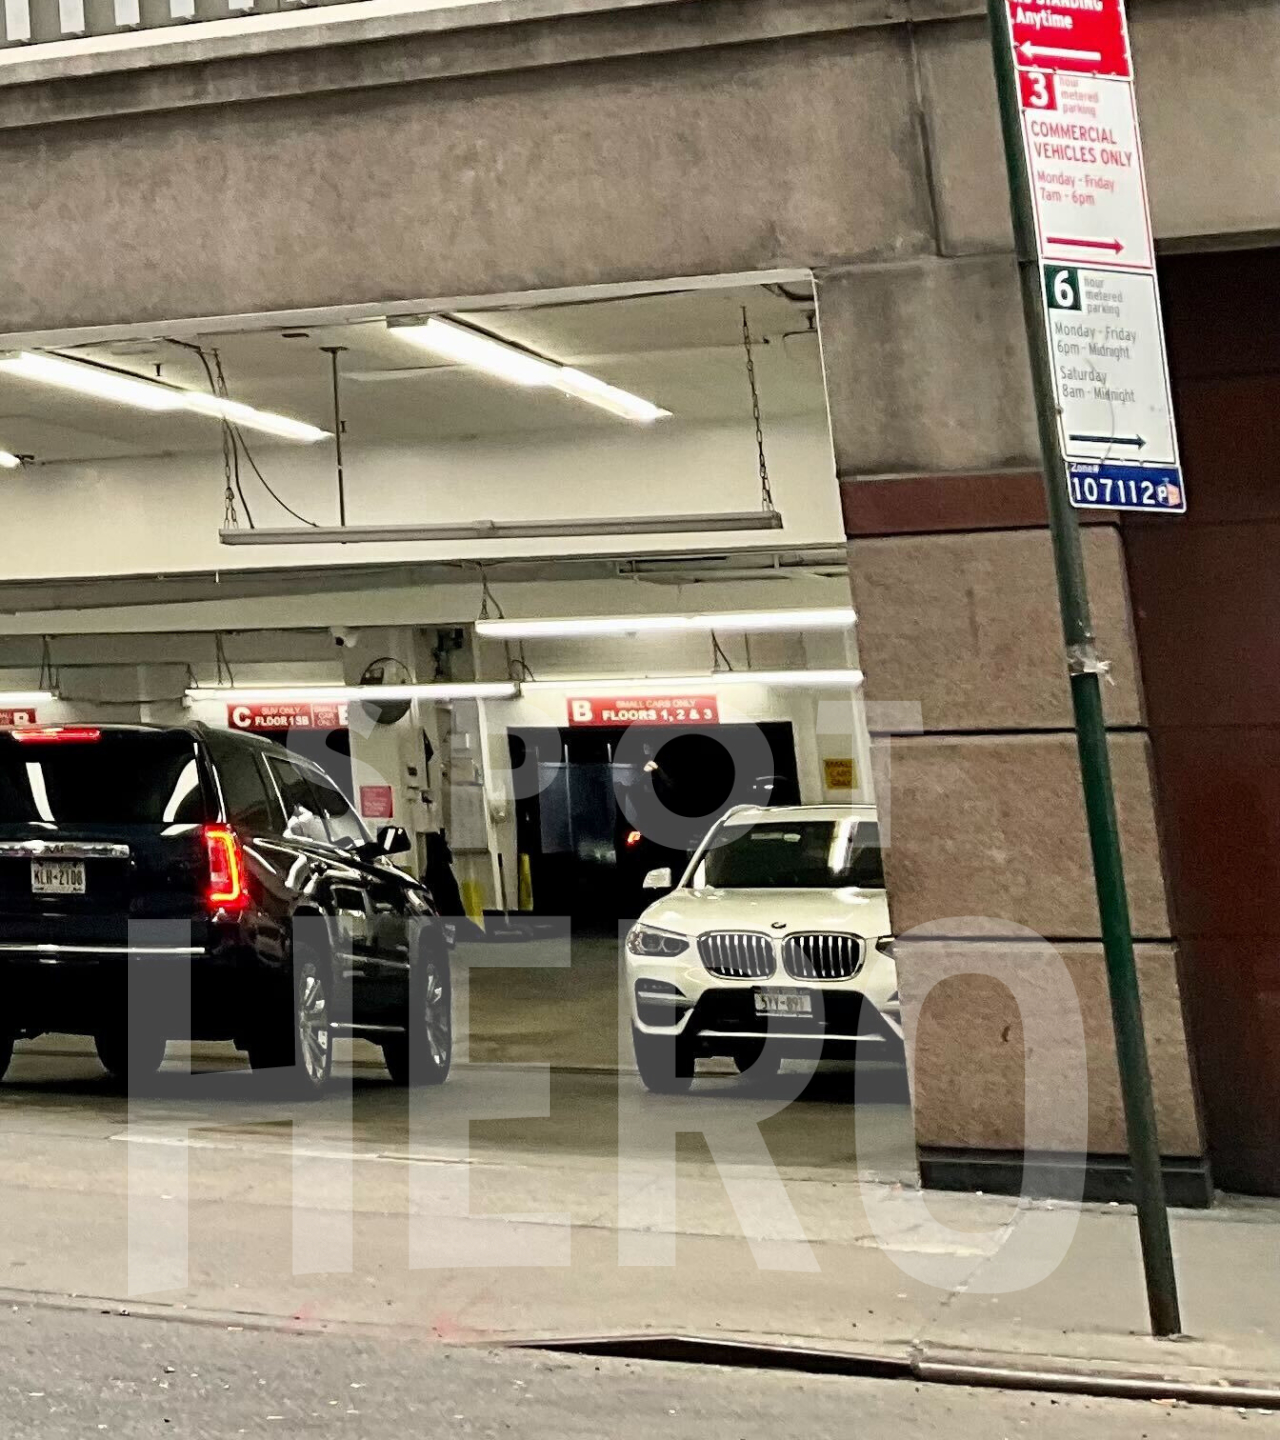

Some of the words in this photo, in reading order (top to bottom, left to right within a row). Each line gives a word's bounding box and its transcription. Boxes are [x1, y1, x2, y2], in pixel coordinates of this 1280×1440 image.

[1016, 7, 1073, 30] Anytime
[1029, 72, 1049, 107] 3
[1061, 88, 1099, 103] metered
[1062, 102, 1096, 118] parking
[1030, 120, 1117, 145] COMMERCIAL
[1034, 142, 1097, 164] VEHICLES
[1100, 150, 1133, 168] ONLY
[1037, 169, 1076, 189] Monday
[1085, 174, 1115, 194] Friday
[1040, 186, 1062, 202] 7am
[1071, 190, 1095, 206] 6pm
[1053, 270, 1074, 308] 6
[1085, 290, 1123, 303] metered
[1087, 303, 1120, 317] parking
[1054, 321, 1096, 339] Monday
[1105, 325, 1136, 344] Friday
[1057, 343, 1080, 358] 6pm
[1088, 344, 1130, 362] Midnight
[1060, 365, 1107, 385] Saturday
[1062, 384, 1085, 398] 8am
[1093, 385, 1136, 404] Midnight
[1072, 477, 1156, 505] 107112
[572, 700, 592, 722] B
[672, 699, 697, 708] ONLY
[233, 706, 251, 728] C
[255, 716, 288, 726] FLOOR
[602, 710, 657, 721] FLOORS
